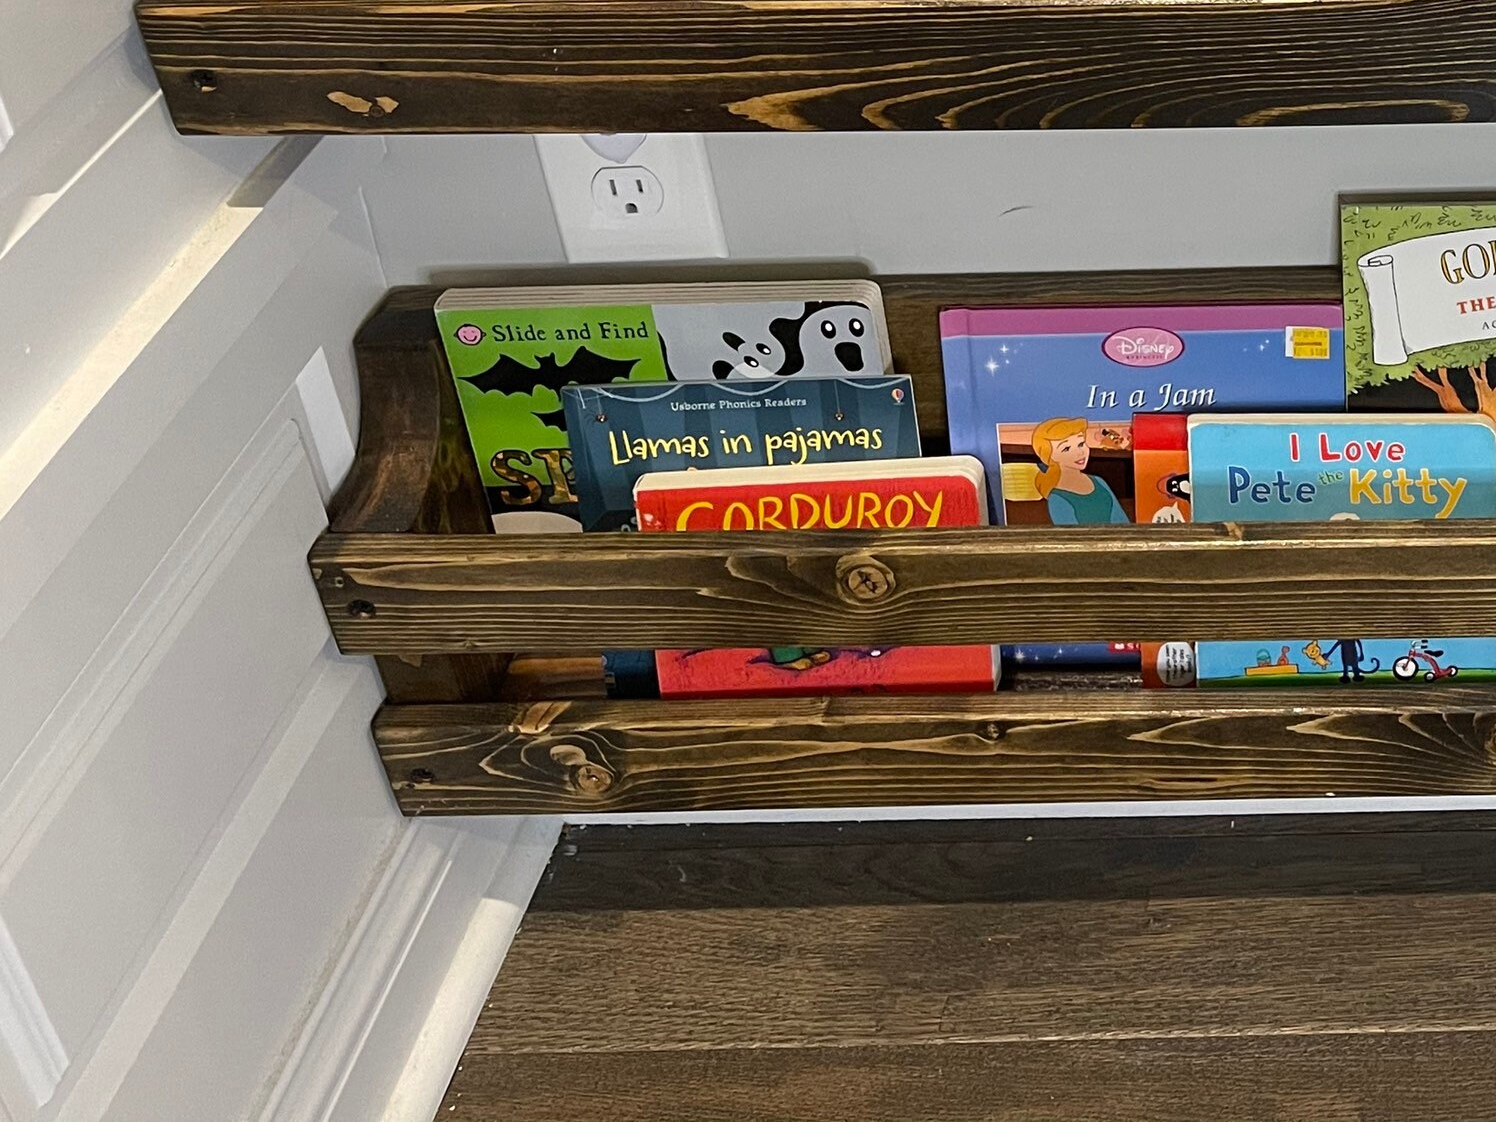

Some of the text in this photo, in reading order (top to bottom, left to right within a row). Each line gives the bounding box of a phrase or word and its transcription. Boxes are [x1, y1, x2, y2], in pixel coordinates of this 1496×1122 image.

[1456, 296, 1496, 315] THE
[492, 321, 649, 342] Slide and Find
[1482, 321, 1490, 330] A
[671, 396, 807, 411] Usborne Phonics Readers
[1087, 383, 1217, 412] In a Jam
[609, 426, 883, 466] Llamas in pajamas
[1289, 431, 1405, 463] I Love
[1227, 465, 1468, 519] Pete the Kitty
[676, 491, 943, 531] CORDUROY
